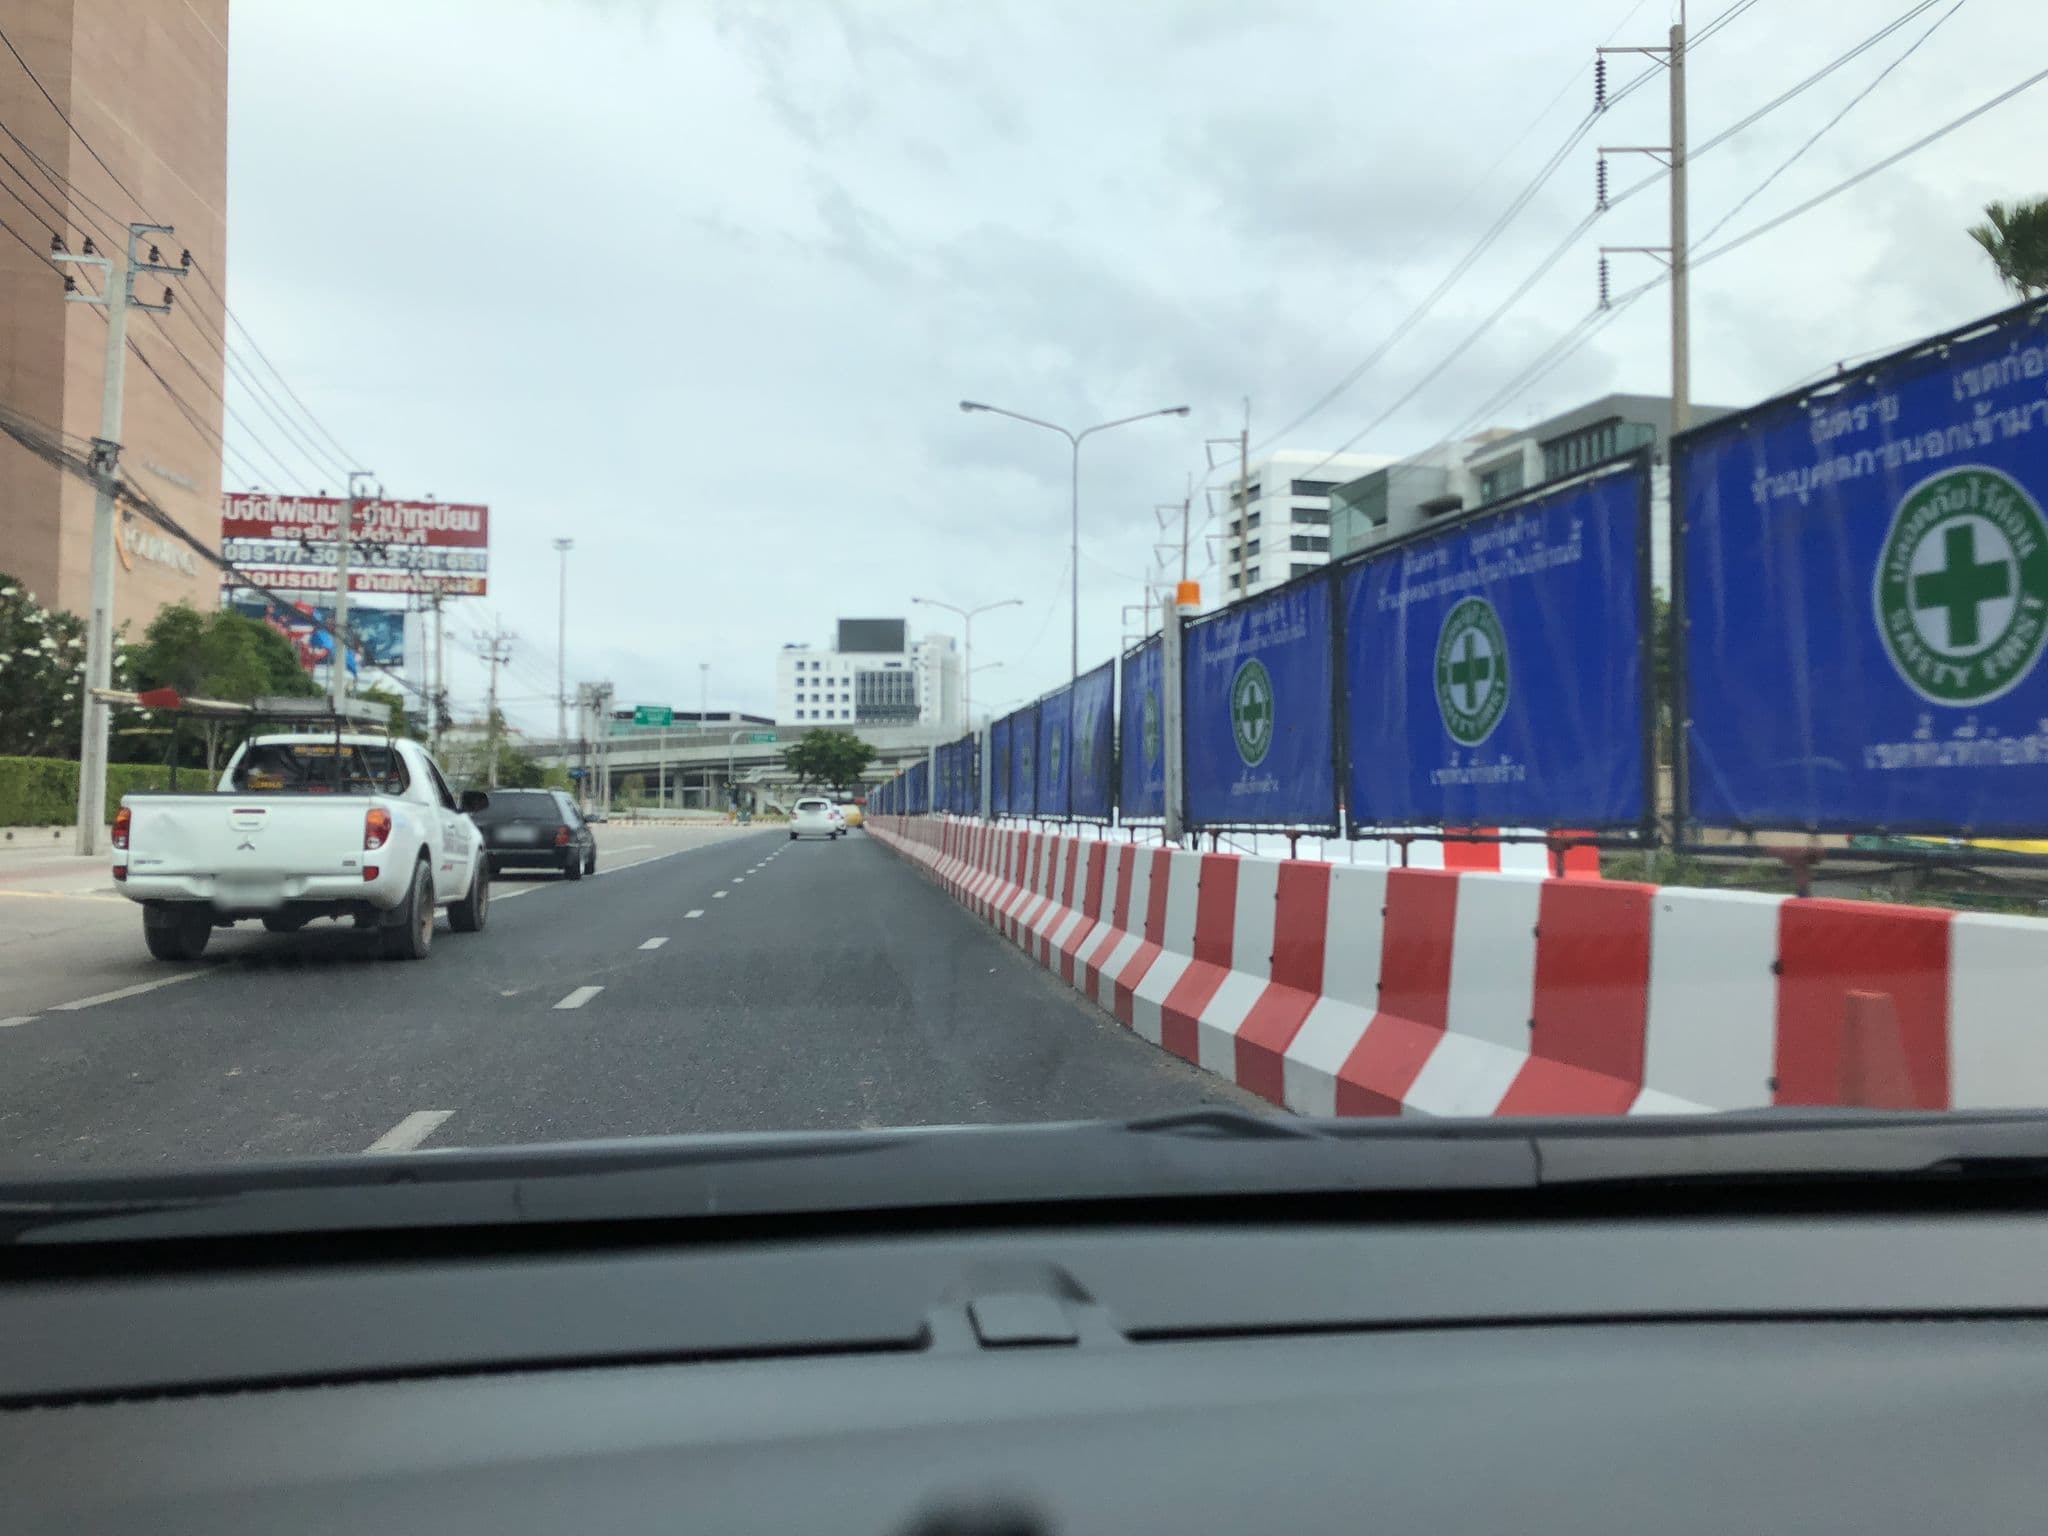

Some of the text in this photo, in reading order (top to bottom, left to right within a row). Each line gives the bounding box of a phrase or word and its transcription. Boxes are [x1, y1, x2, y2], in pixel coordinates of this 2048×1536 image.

[1952, 340, 2048, 401] เขตก่อ
[1889, 607, 1971, 688] SAFETY
